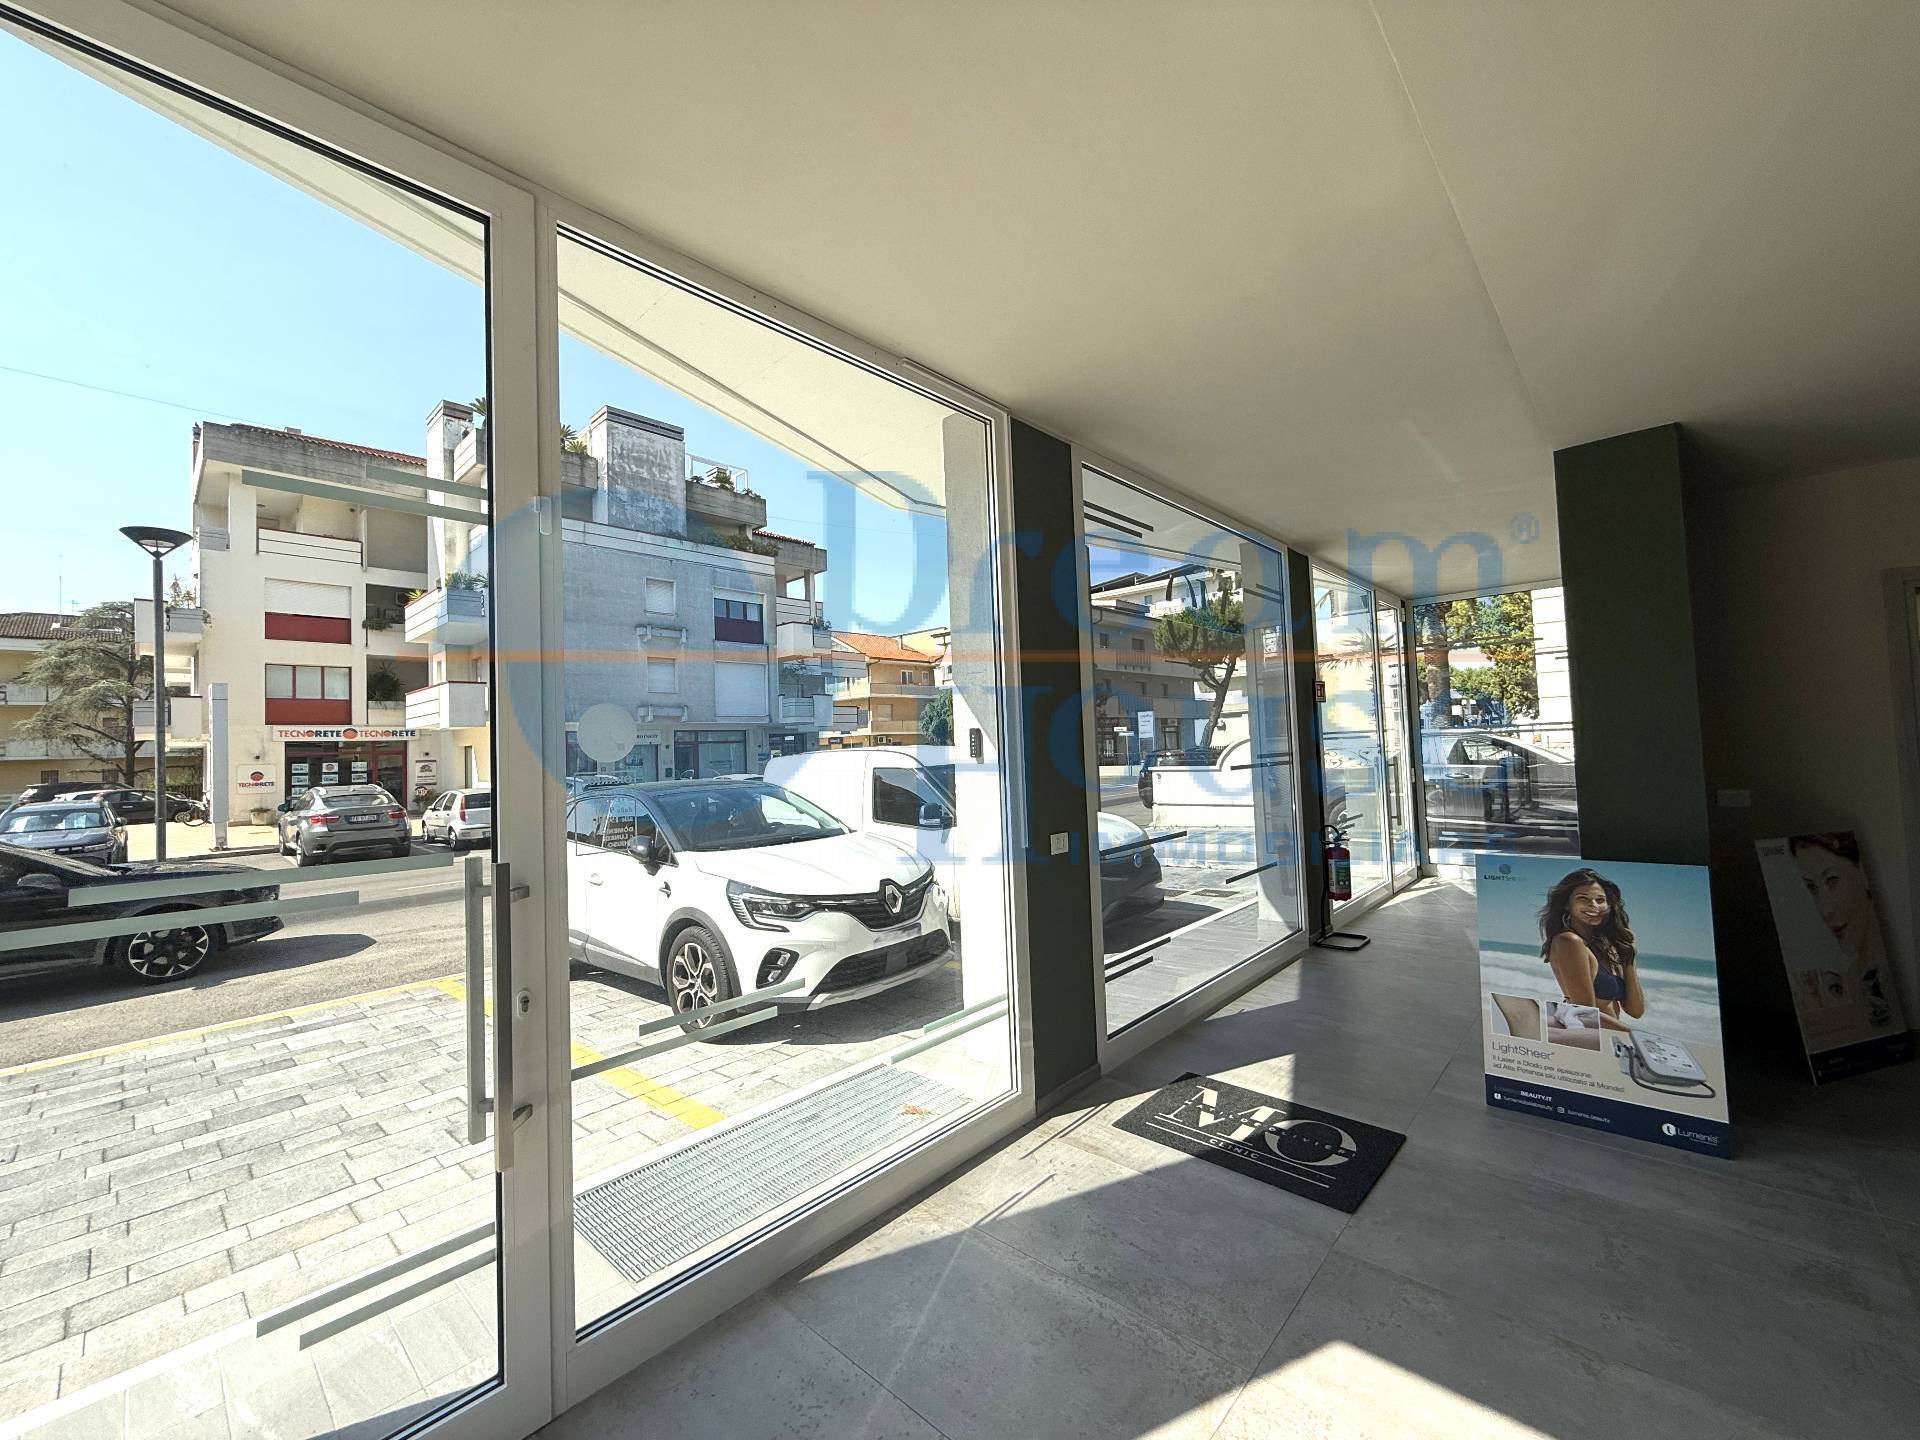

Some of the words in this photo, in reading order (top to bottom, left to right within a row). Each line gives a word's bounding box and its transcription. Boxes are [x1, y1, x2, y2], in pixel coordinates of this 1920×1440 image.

[278, 729, 342, 738] TECNORETE
[359, 729, 416, 738] TECNORETE
[1498, 1055, 1515, 1064] Laser
[1209, 1138, 1260, 1160] CLINIC
